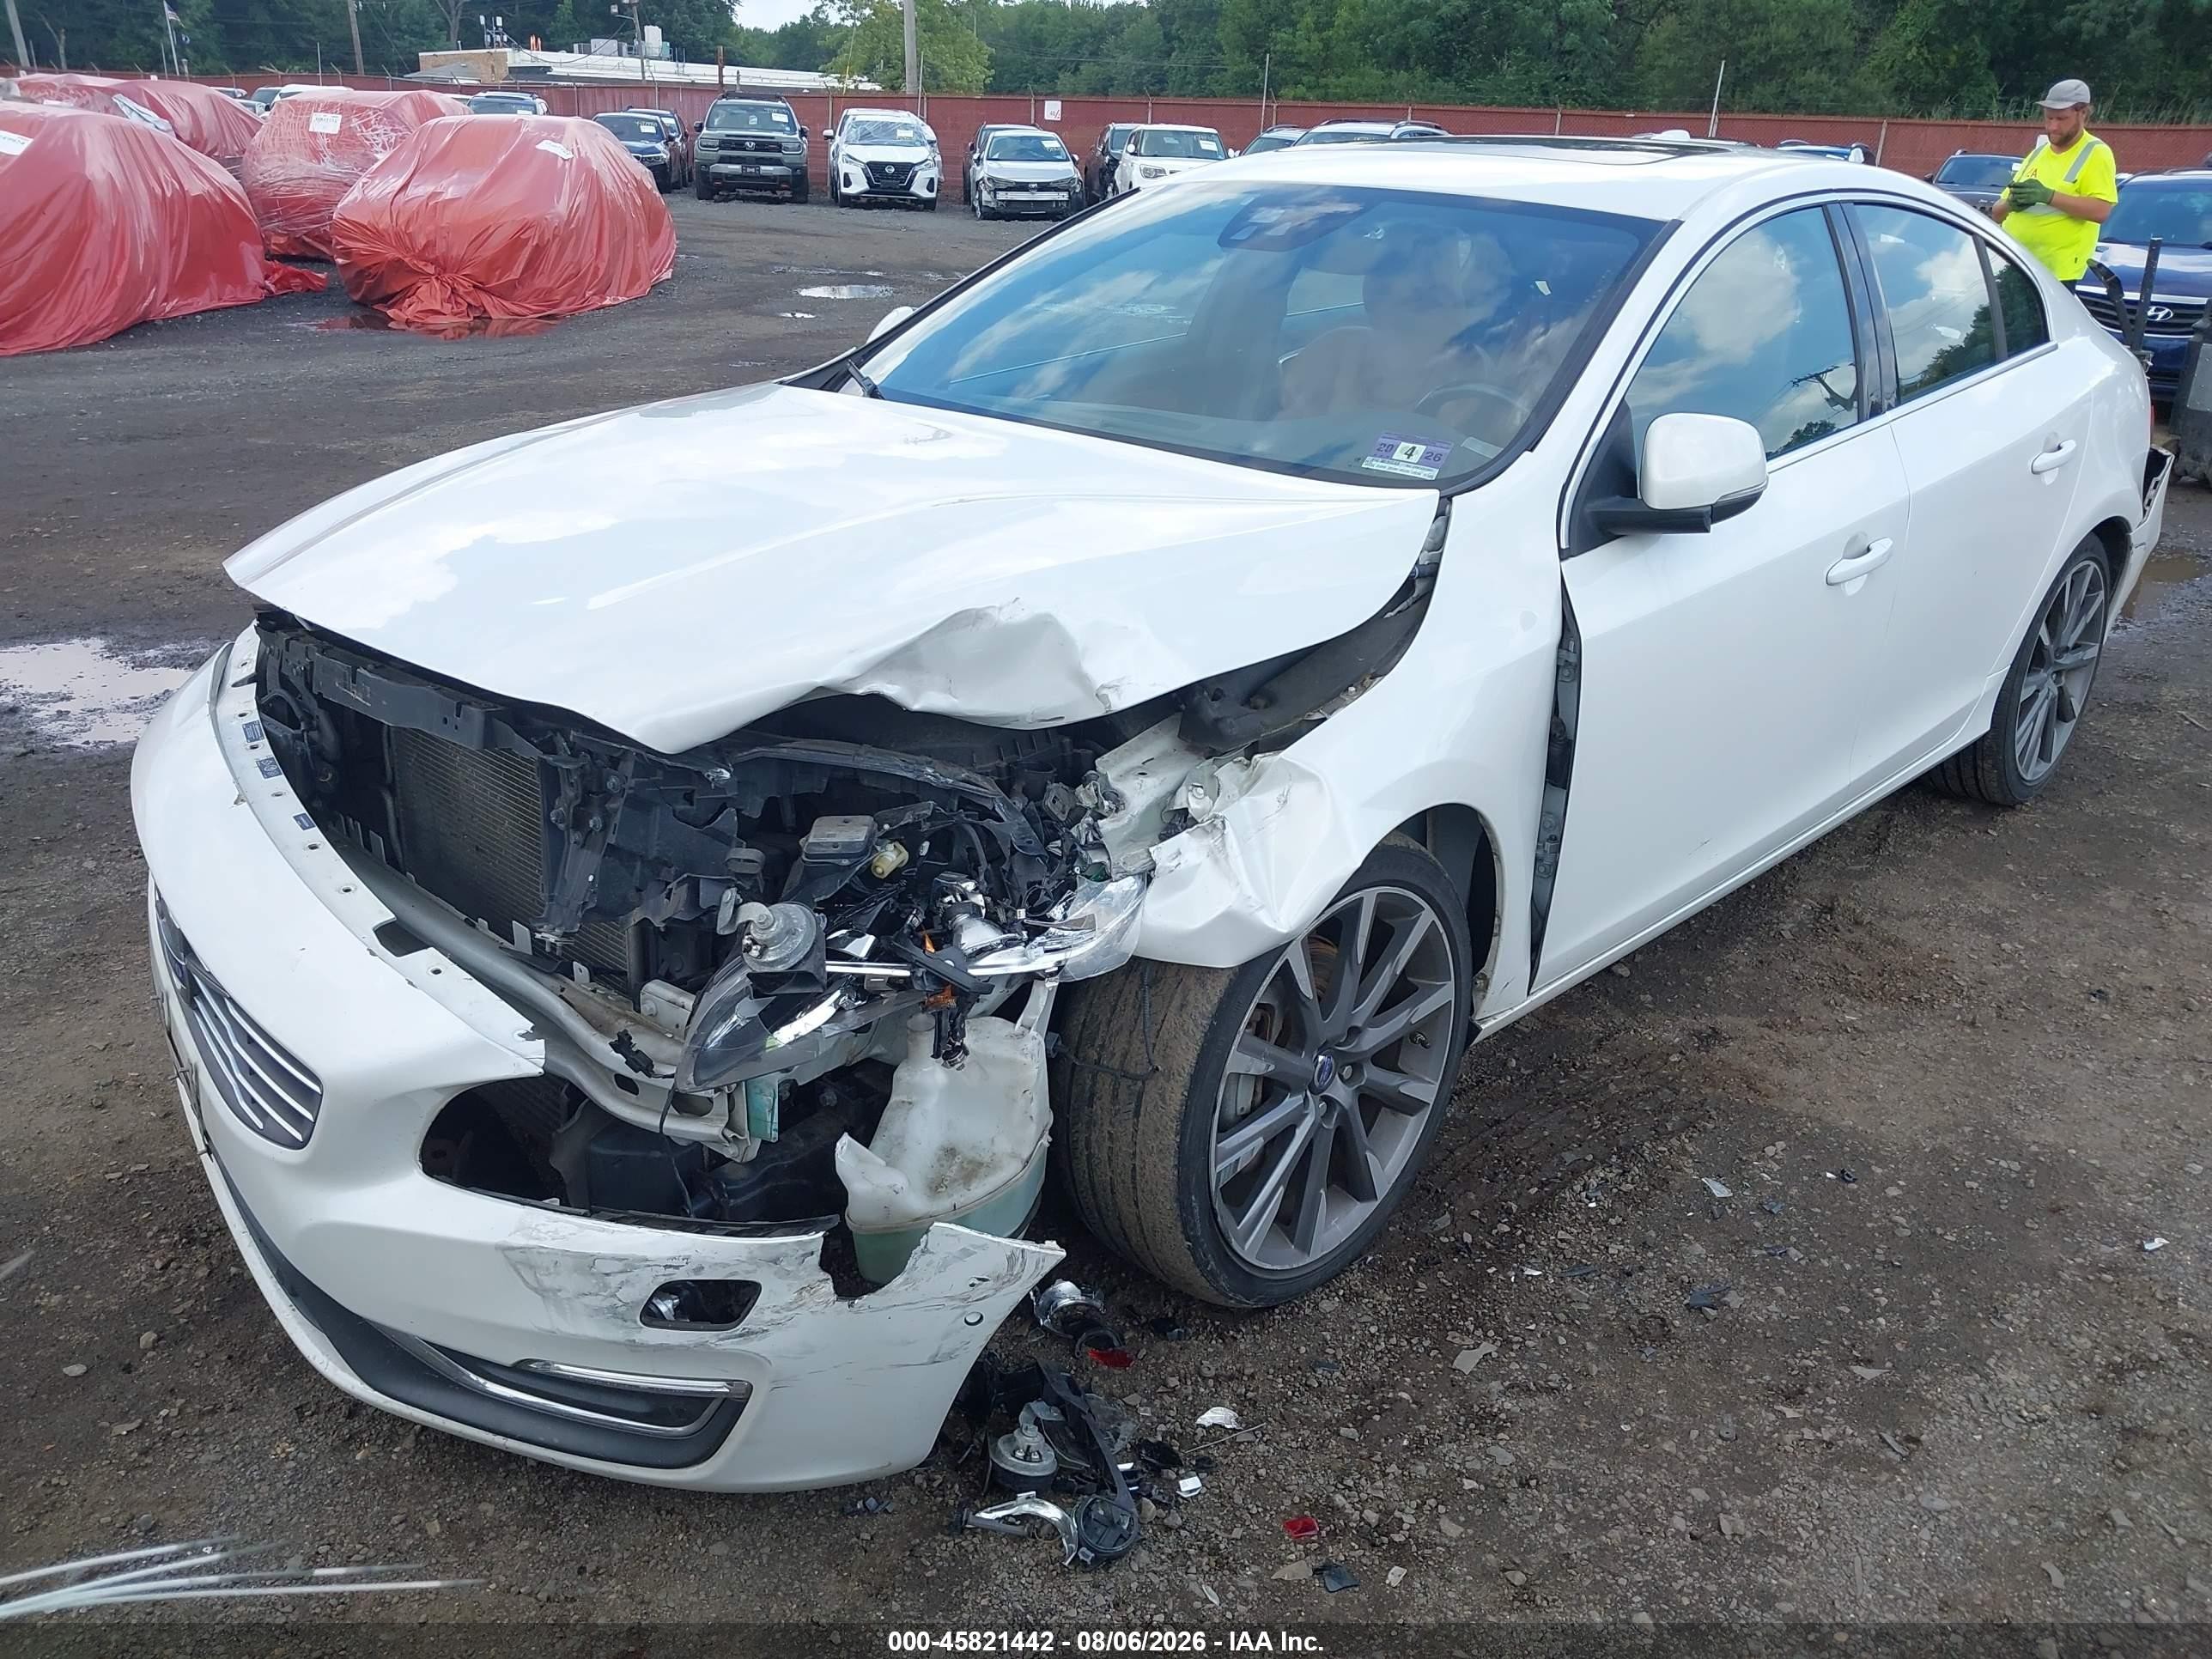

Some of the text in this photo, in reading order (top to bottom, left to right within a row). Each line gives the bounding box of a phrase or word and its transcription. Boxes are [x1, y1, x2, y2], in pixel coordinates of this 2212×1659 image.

[1376, 442, 1443, 462] 20 4 26
